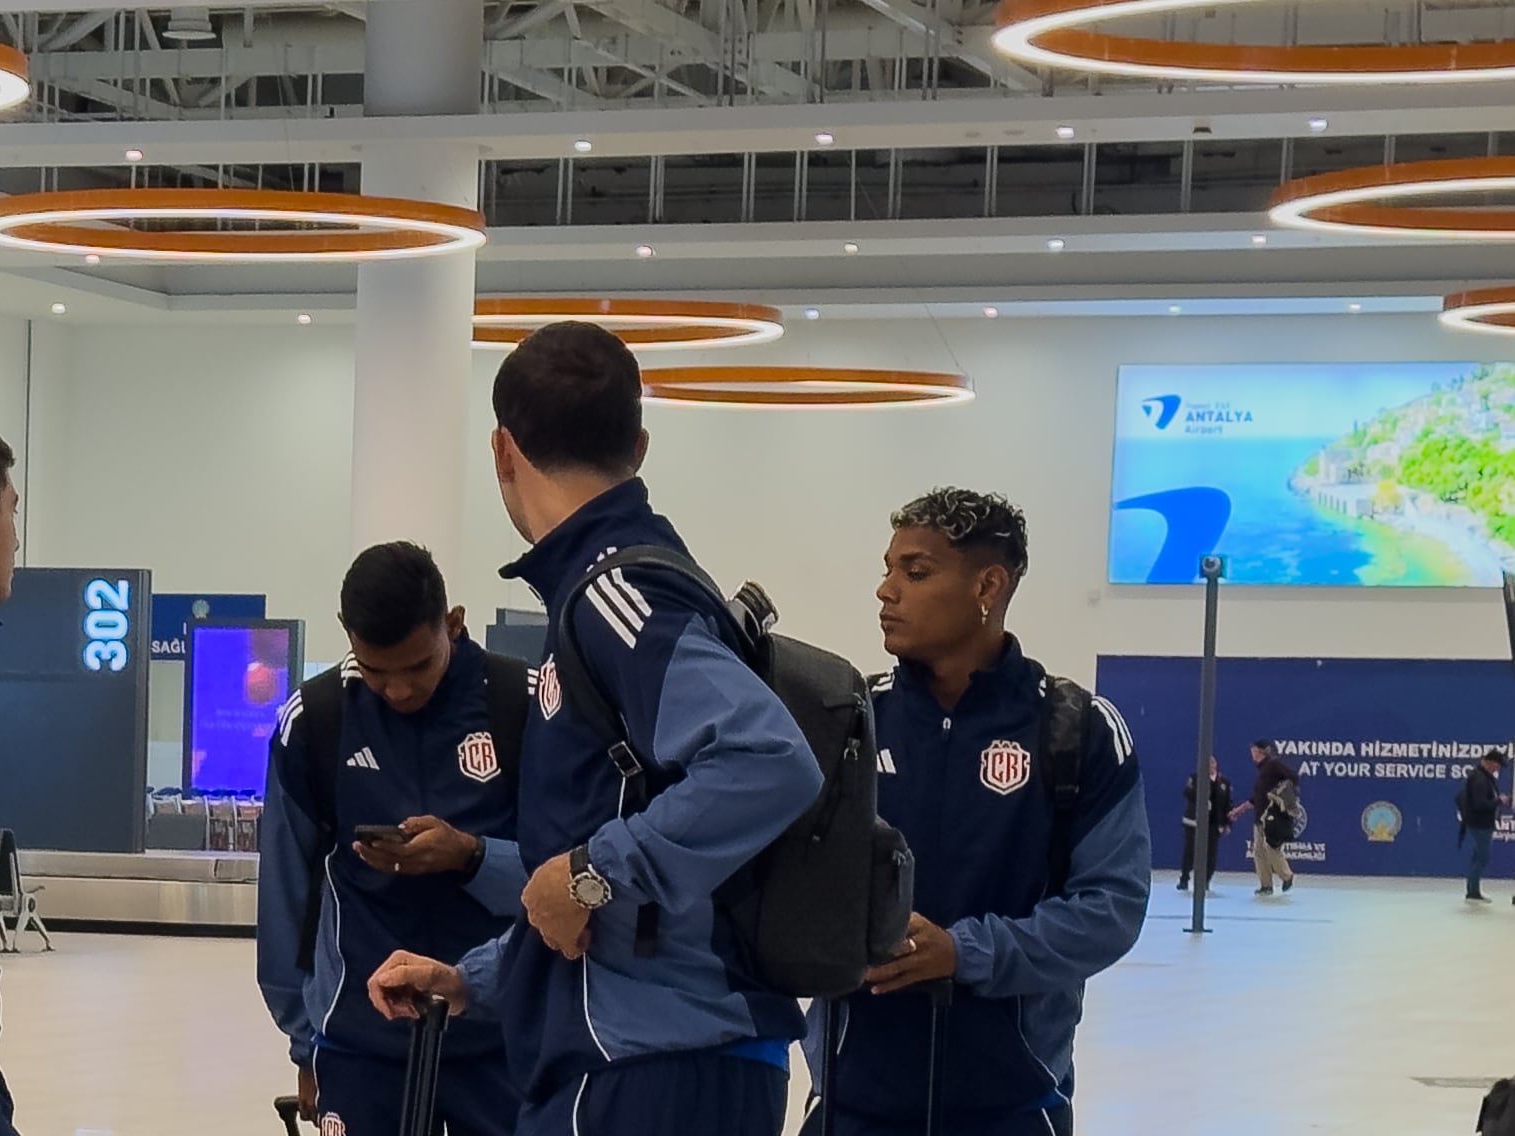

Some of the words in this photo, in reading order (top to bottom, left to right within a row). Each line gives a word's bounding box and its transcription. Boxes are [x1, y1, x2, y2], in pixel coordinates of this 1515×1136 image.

[1185, 410, 1253, 423] ANTALYA
[84, 578, 130, 672] 302
[1274, 740, 1356, 756] YAKINDA
[1298, 761, 1320, 776] AT
[1324, 761, 1371, 777] YOUR
[1374, 762, 1446, 779] SERVICE
